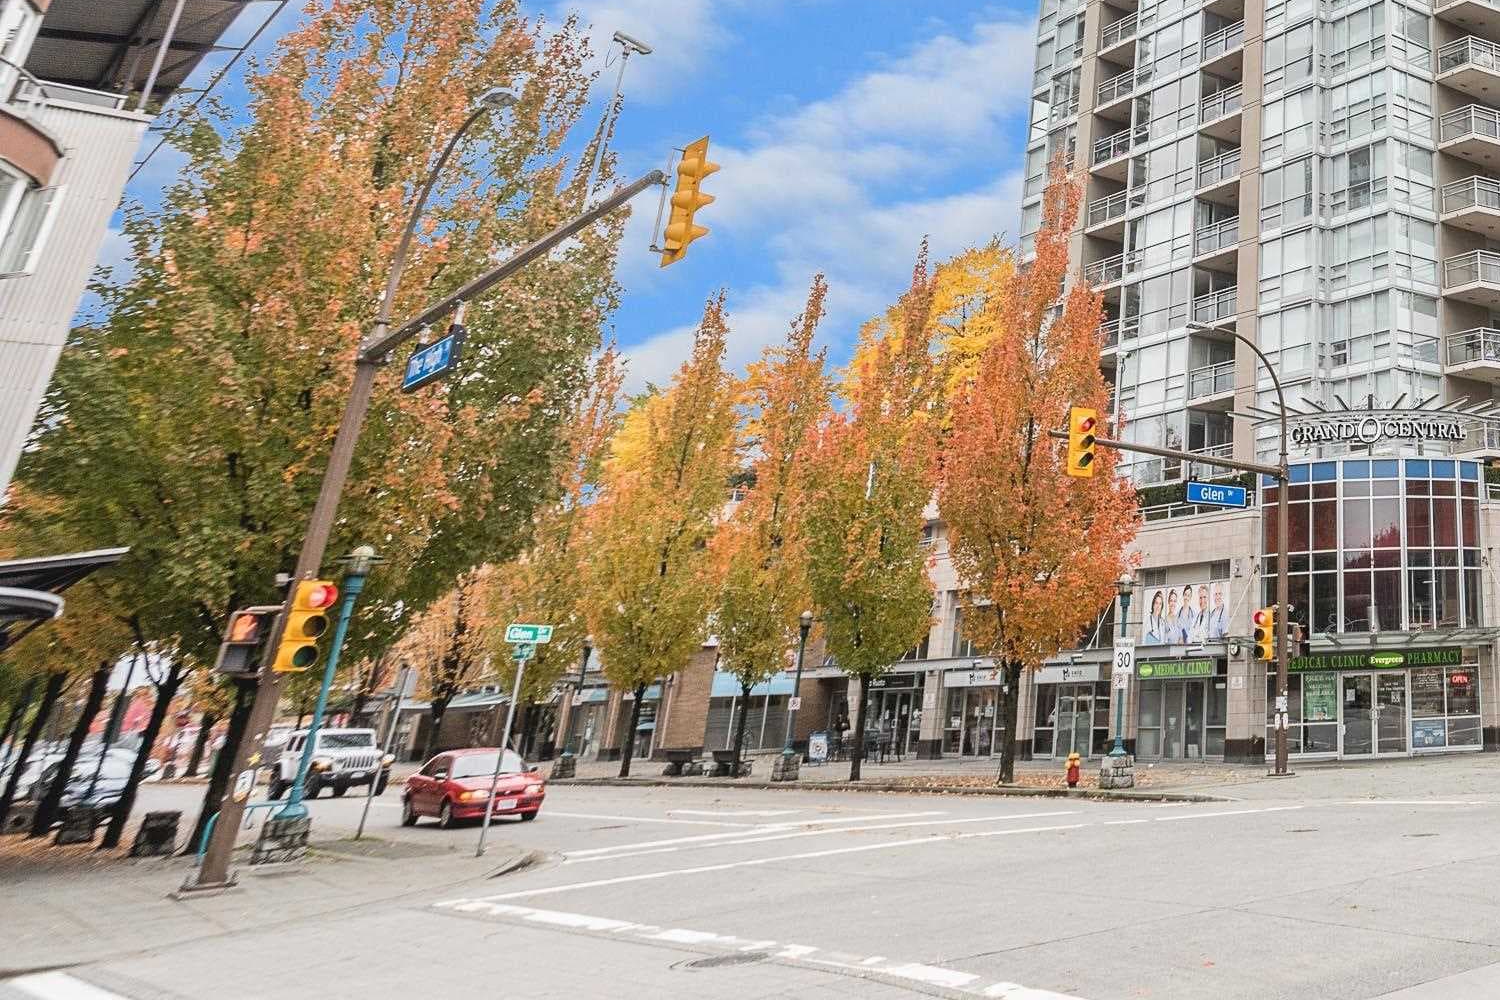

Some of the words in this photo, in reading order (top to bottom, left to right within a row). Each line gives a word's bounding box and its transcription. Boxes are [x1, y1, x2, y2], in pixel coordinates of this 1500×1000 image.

[1291, 421, 1355, 442] GRAND
[1383, 421, 1467, 440] CENTRAL
[1201, 487, 1224, 500] Glen
[510, 627, 534, 639] Glen
[1117, 652, 1130, 668] 30
[1331, 655, 1366, 668] CLINIC
[1370, 655, 1404, 665] Evergreen
[1407, 650, 1462, 664] PHARMACY
[1153, 663, 1185, 676] MEDICAL
[1187, 661, 1212, 674] CLINIC
